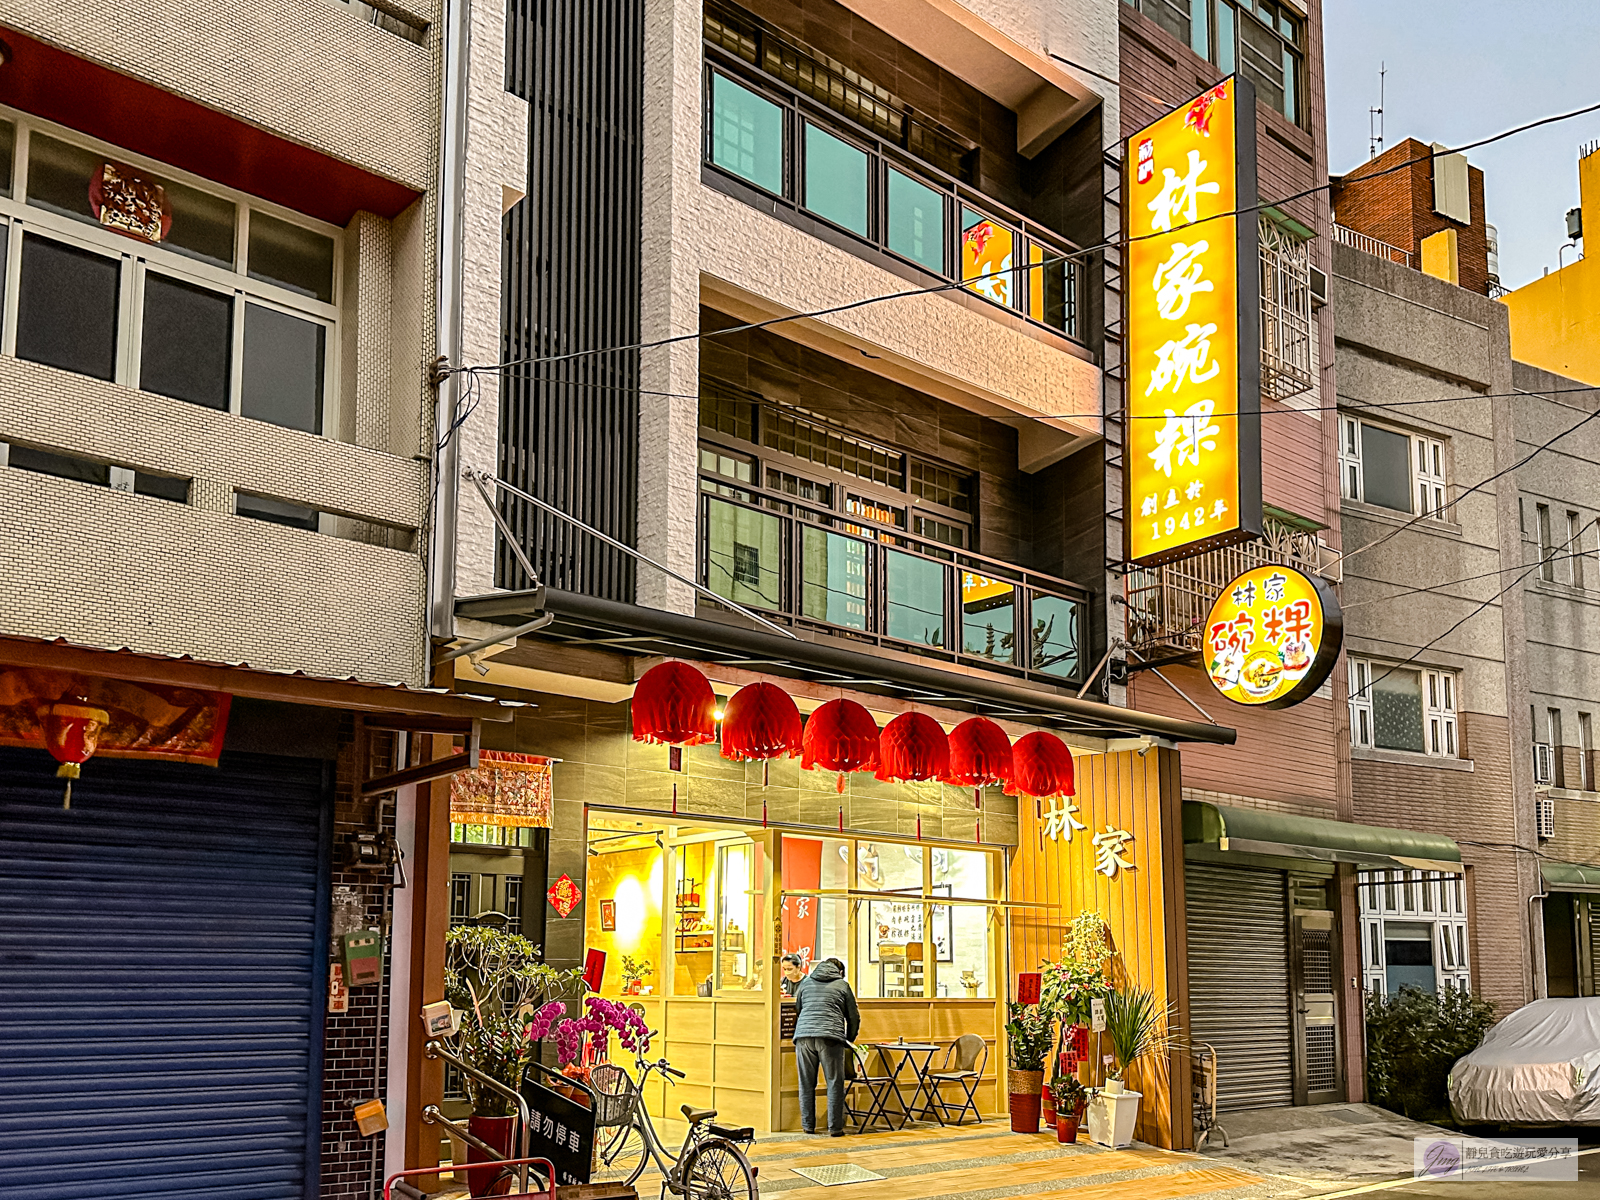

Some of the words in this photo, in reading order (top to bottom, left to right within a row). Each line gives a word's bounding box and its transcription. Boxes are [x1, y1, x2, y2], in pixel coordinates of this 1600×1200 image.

[1145, 150, 1220, 478] 林家碗粿
[1141, 479, 1204, 517] 創立於
[1151, 499, 1228, 540] 1942年
[1232, 573, 1287, 608] 林家
[1210, 601, 1312, 657] 碗粿
[1043, 794, 1135, 877] 林家
[530, 1108, 580, 1153] 請勿停車
